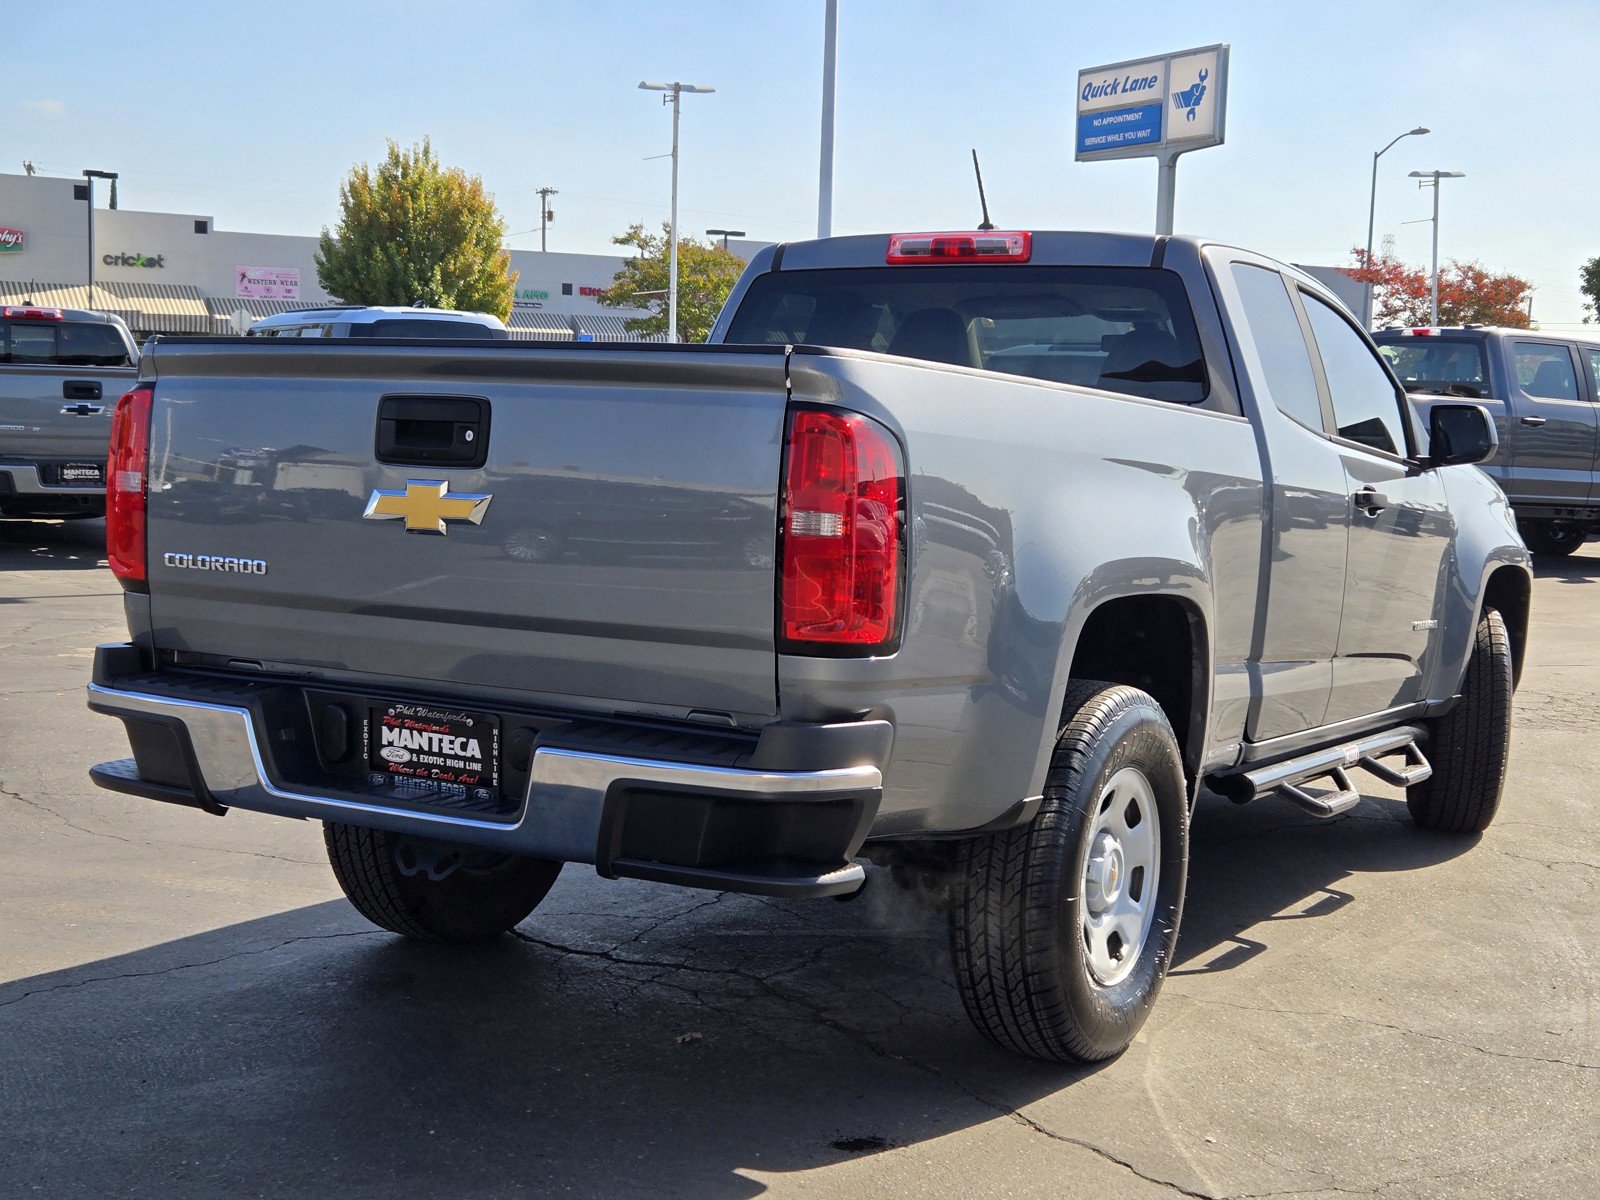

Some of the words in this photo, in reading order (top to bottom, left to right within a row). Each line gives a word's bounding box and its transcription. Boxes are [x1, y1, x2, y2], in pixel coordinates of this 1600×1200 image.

[1081, 78, 1120, 101] Quick
[1121, 75, 1158, 94] Lane
[1093, 118, 1102, 127] NO
[1102, 112, 1143, 125] APPOINTMENT
[1084, 135, 1106, 146] SERVICE
[1106, 132, 1124, 144] WHILE
[1124, 130, 1136, 140] YOU
[1137, 129, 1151, 138] WAIT
[0, 229, 22, 248] hy's
[102, 252, 165, 269] cricket
[247, 278, 277, 286] WESTERN
[280, 279, 299, 287] WEAR
[63, 468, 100, 476] MANTECA
[164, 552, 267, 575] COLORADO
[395, 704, 416, 716] Phil
[383, 715, 402, 726] Phil
[404, 719, 450, 733] Waterford's
[381, 725, 482, 759] MANTECA
[385, 749, 406, 760] Ford
[411, 753, 418, 762] &
[420, 754, 445, 766] EXOTIC
[446, 758, 464, 769] HIGH
[466, 762, 482, 772] LINE
[388, 762, 415, 775] Where
[416, 767, 429, 777] the
[431, 768, 456, 781] Deals
